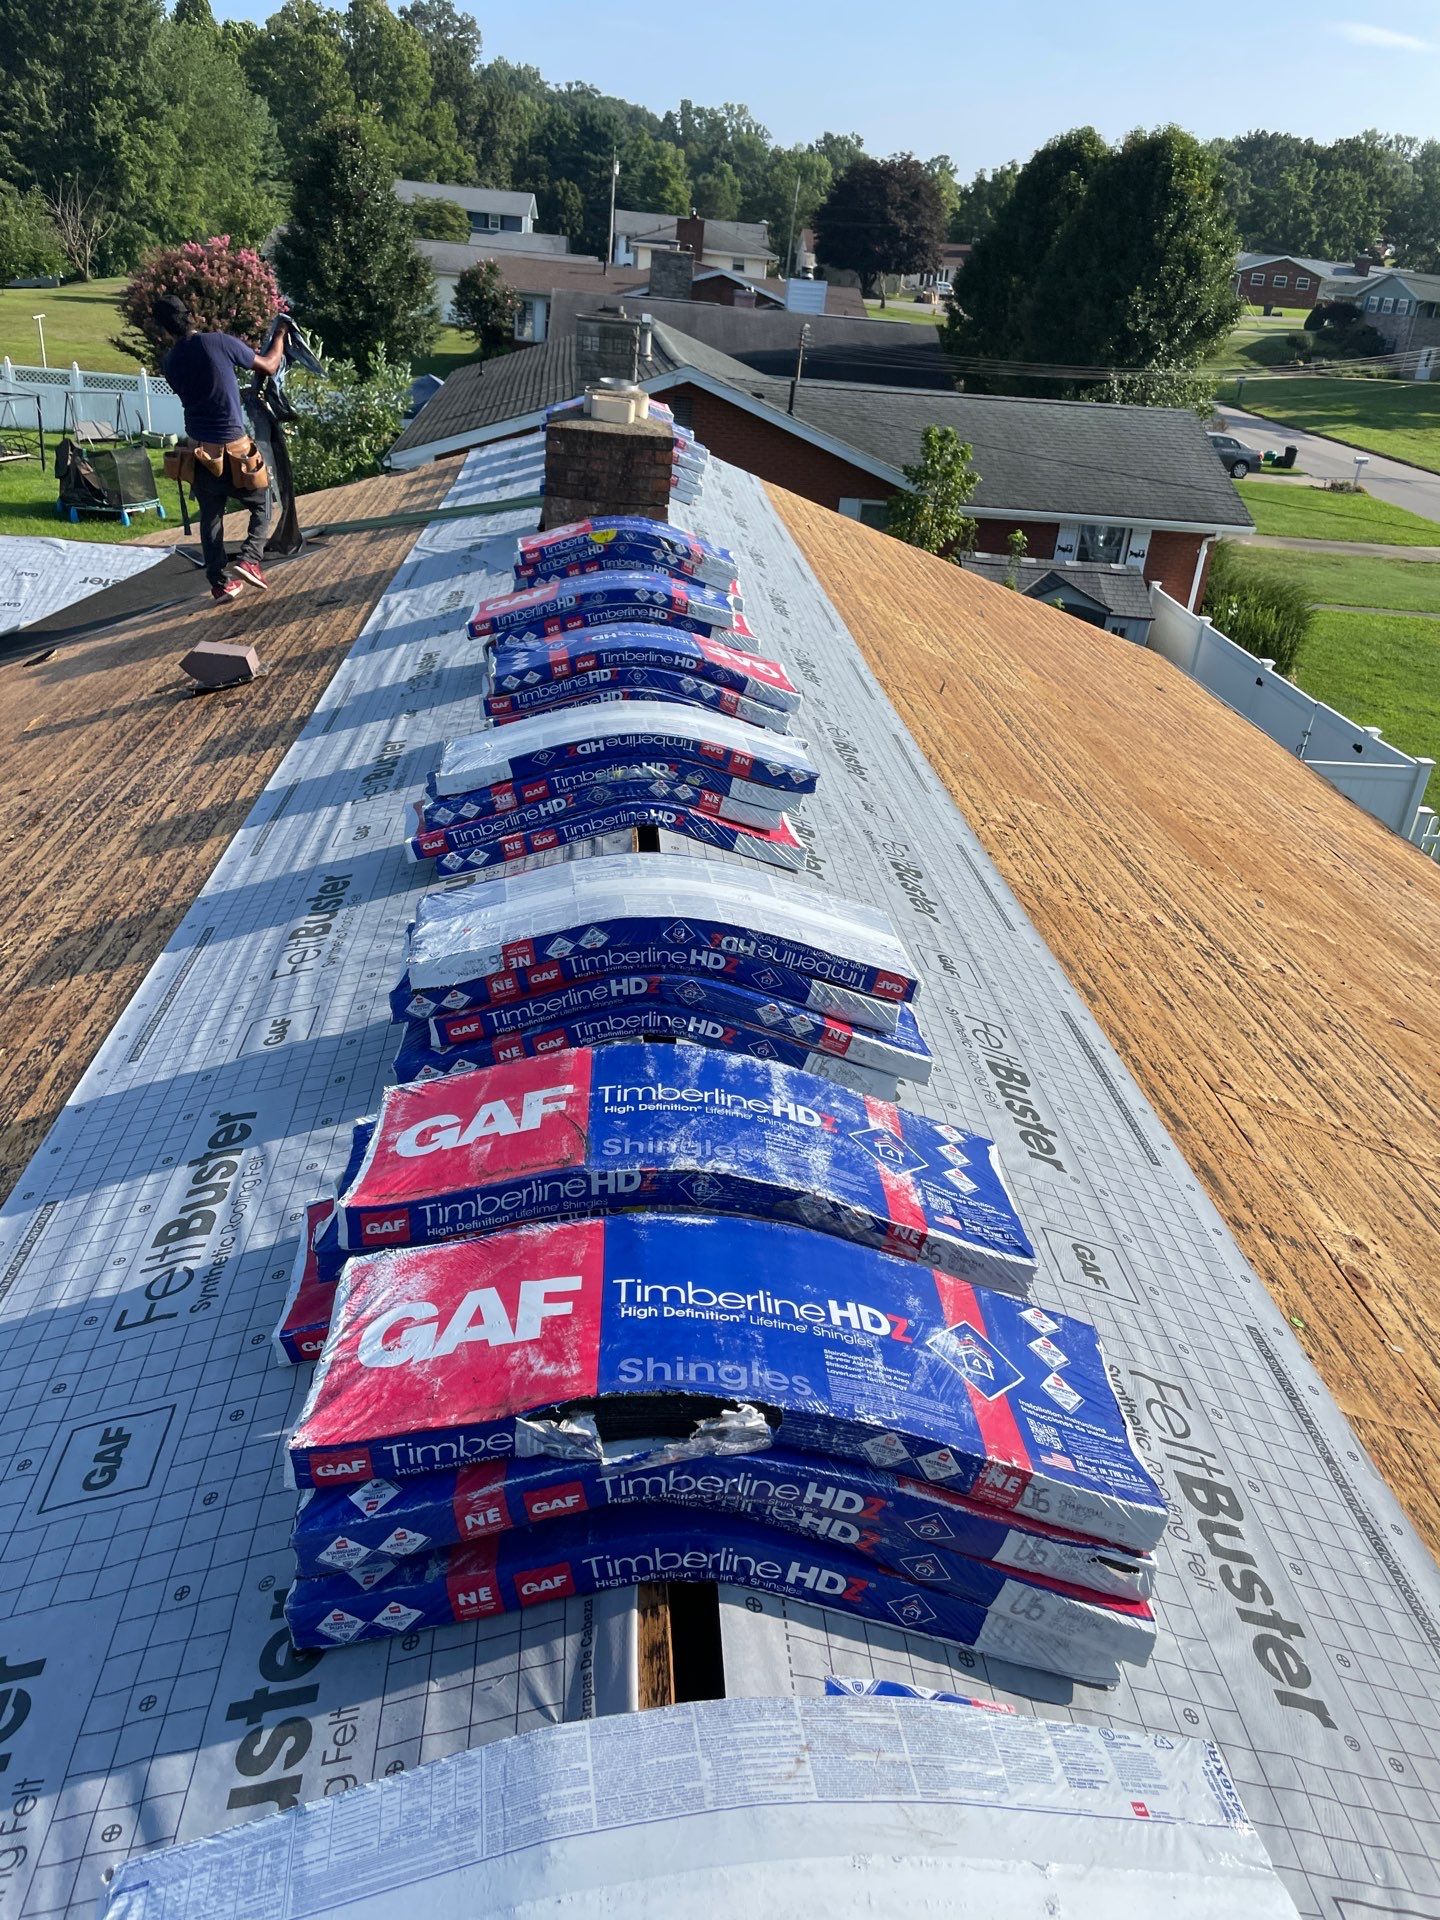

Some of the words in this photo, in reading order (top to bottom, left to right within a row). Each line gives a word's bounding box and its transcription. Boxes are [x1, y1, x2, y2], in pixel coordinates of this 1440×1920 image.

[475, 622, 491, 631] GAF
[567, 620, 582, 628] GAF
[554, 663, 568, 674] NE
[577, 659, 596, 668] GAF
[704, 744, 723, 754] GAF
[735, 755, 750, 766] NE
[525, 787, 545, 798] GAF
[423, 840, 444, 850] GAF
[505, 841, 521, 851] NE
[534, 836, 555, 846] GAF
[879, 834, 941, 924] FeltBuster
[270, 873, 353, 981] FeltBuster
[509, 955, 531, 969] NE
[492, 978, 514, 992] NE
[531, 970, 558, 984] GAF
[877, 980, 904, 993] GAF
[263, 1018, 292, 1046] GAF
[450, 1023, 479, 1036] GAF
[828, 1028, 847, 1042] NE
[499, 1046, 521, 1060] NE
[537, 1037, 565, 1051] GAF
[964, 1015, 1067, 1174] FeltBuster
[604, 1105, 635, 1115] High
[639, 1103, 698, 1113] Definition
[395, 1084, 574, 1158] GAF
[602, 1137, 753, 1164] Shingles
[114, 1111, 258, 1332] FeltBuster
[365, 1219, 407, 1235] GAF
[427, 1224, 453, 1236] High
[456, 1215, 510, 1231] Definition
[189, 1236, 236, 1314] Synthetic
[221, 1177, 262, 1235] Roofing
[243, 1153, 267, 1178] Felt
[892, 1226, 921, 1244] NE
[1071, 1243, 1110, 1290] GAF
[355, 1276, 582, 1368] GAF
[620, 1307, 658, 1318] High
[664, 1308, 740, 1322] Definition
[812, 1326, 875, 1348] Shingles
[973, 1359, 982, 1369] 4
[618, 1357, 812, 1396] Shingles
[82, 1426, 132, 1491] GAF
[316, 1459, 366, 1477] GAF
[986, 1467, 1021, 1493] NE
[465, 1508, 501, 1530] NE
[531, 1495, 581, 1516] GAF
[1128, 1369, 1339, 1730] FeltBuster
[596, 1577, 629, 1588] High
[1182, 1549, 1218, 1593] Felt
[458, 1586, 494, 1606] NE
[521, 1574, 568, 1596] GAF
[581, 1650, 592, 1671] De
[322, 1706, 360, 1766] Felt
[0, 1778, 45, 1836] Felt
